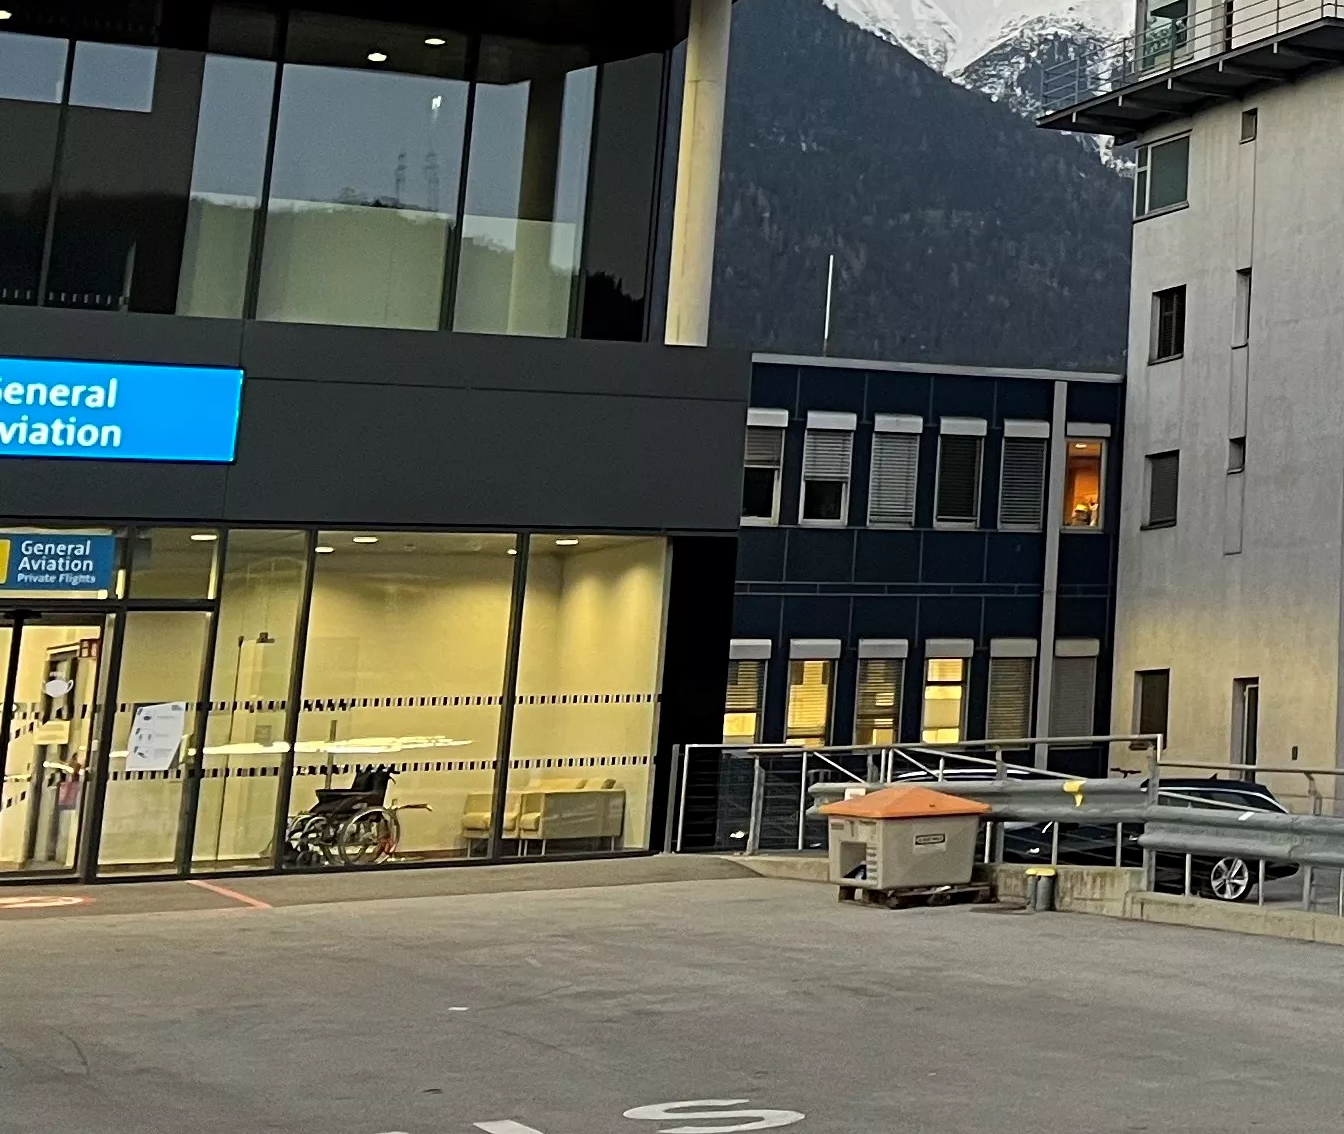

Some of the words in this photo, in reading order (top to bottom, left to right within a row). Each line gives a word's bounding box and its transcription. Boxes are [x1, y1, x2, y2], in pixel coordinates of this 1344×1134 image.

[0, 377, 118, 408] eneral
[0, 415, 121, 447] viation
[21, 539, 91, 555] General
[18, 556, 93, 572] Aviation
[17, 573, 56, 583] Private
[59, 573, 96, 585] Flights
